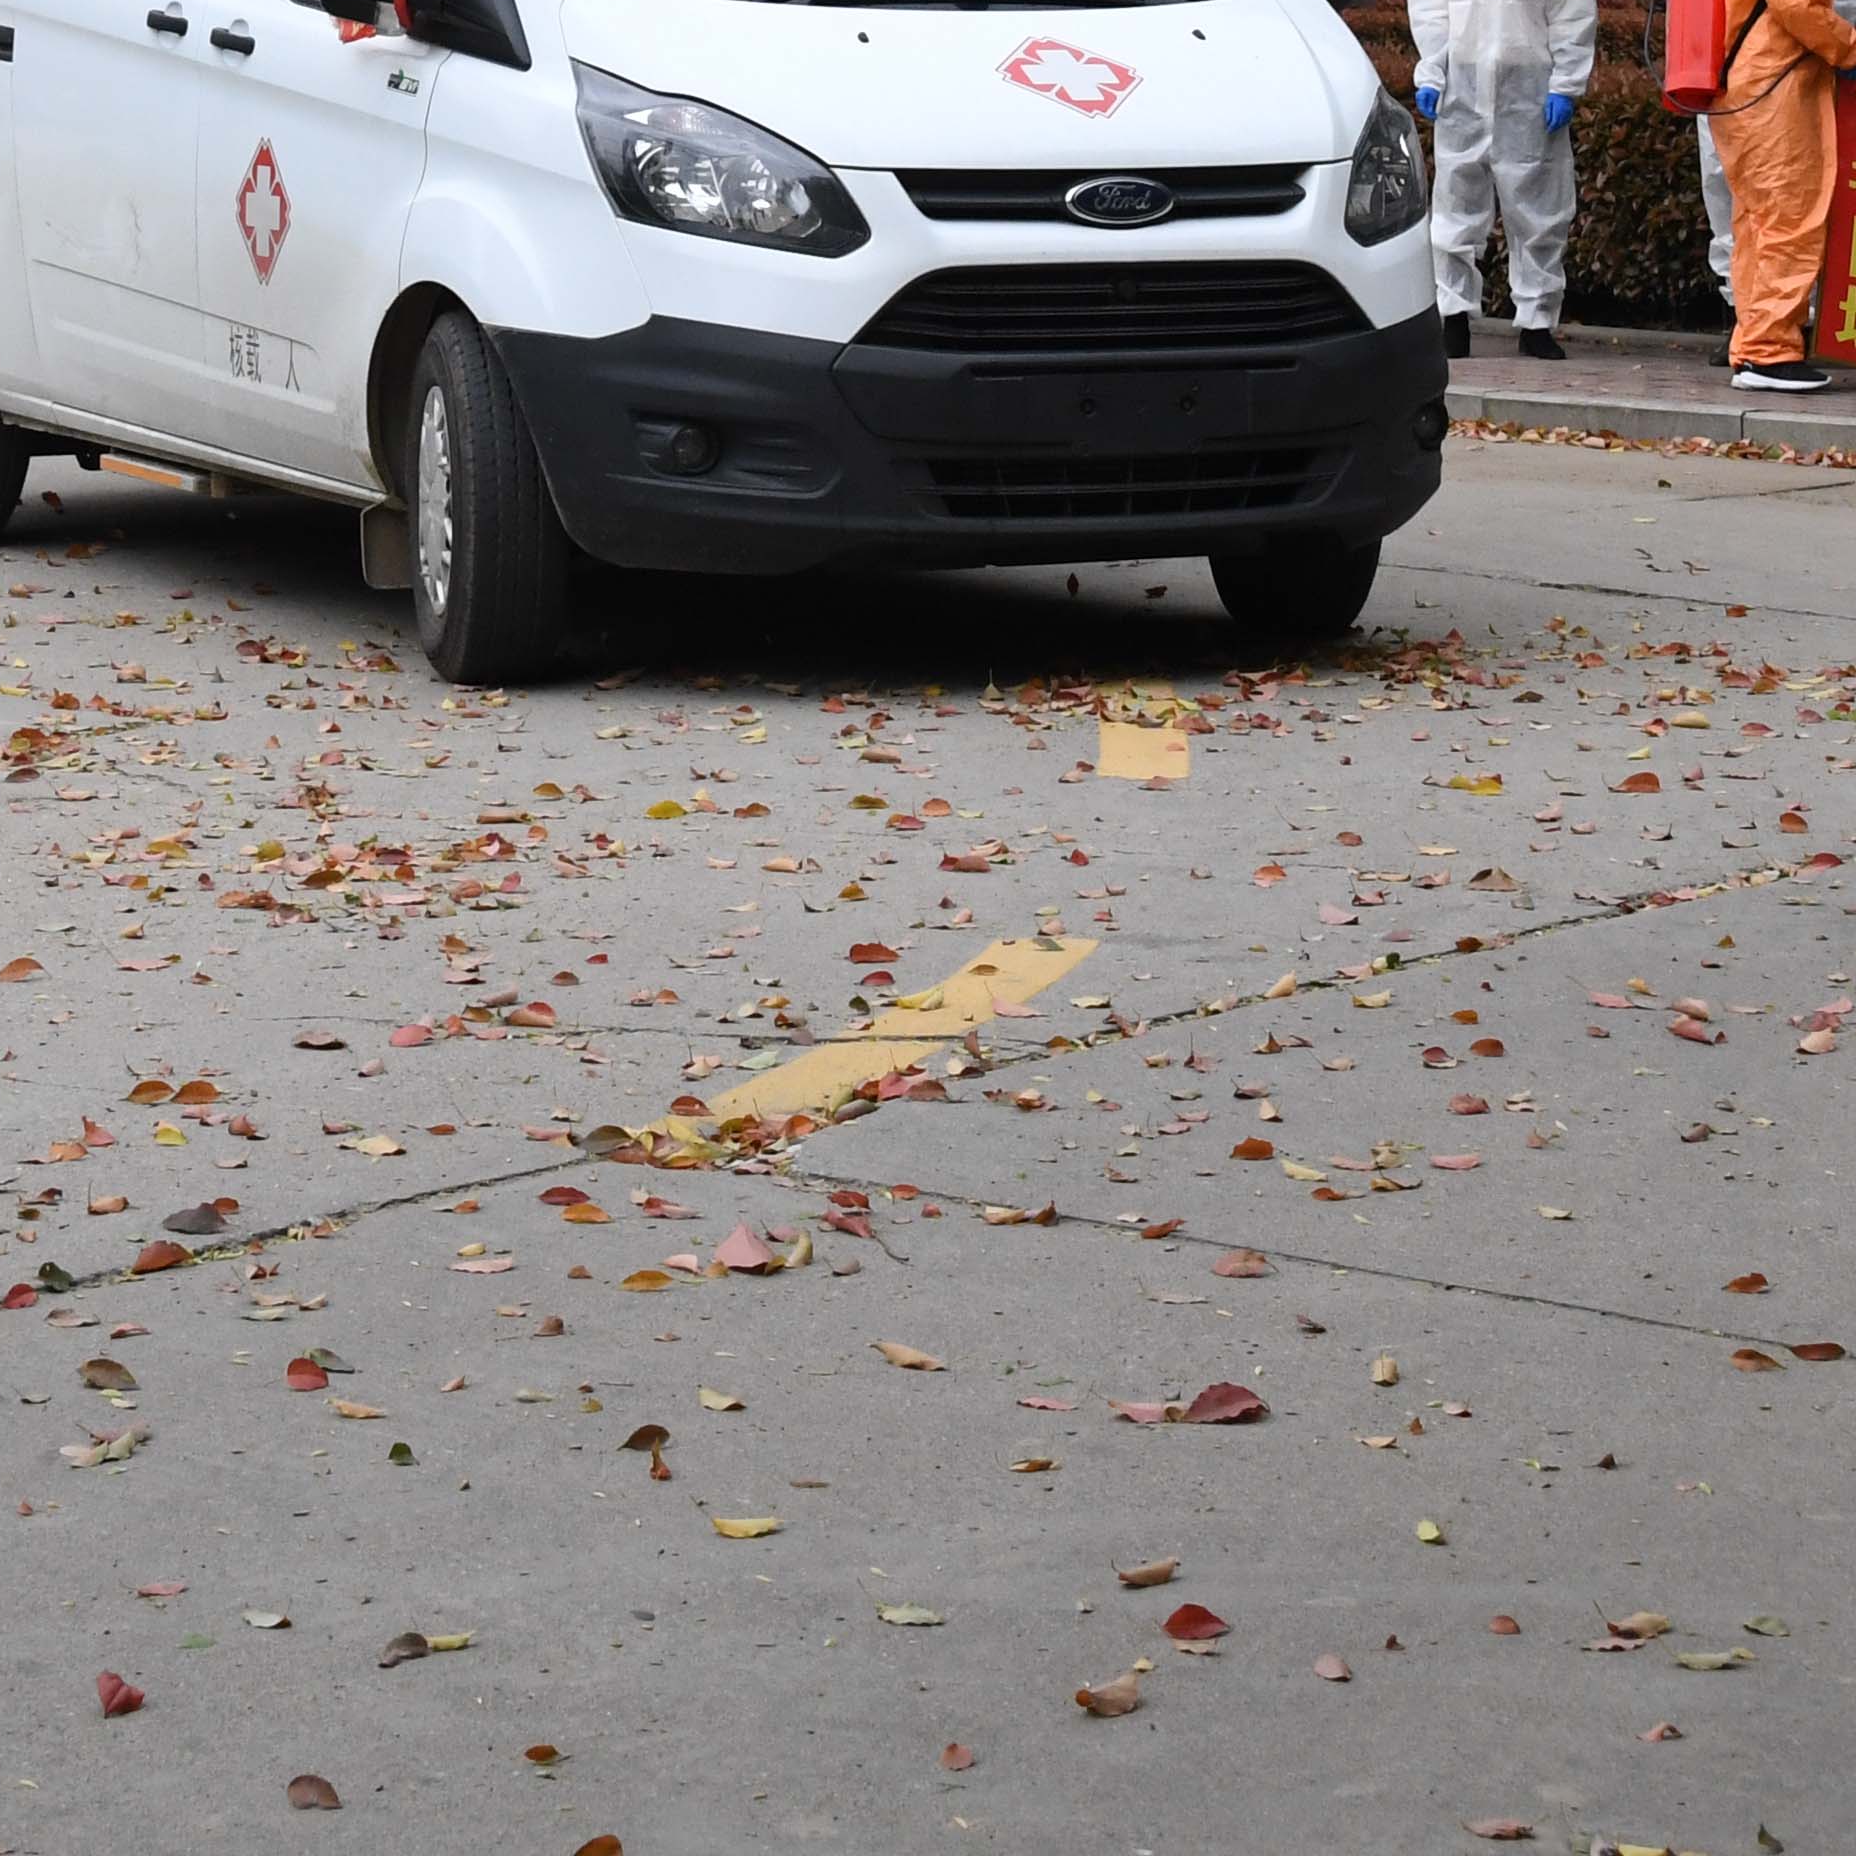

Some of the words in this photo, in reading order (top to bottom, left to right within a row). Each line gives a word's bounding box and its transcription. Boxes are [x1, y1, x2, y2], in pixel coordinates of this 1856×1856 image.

[1094, 184, 1151, 210] Ford
[229, 325, 261, 383] 核载
[285, 339, 300, 392] 人
